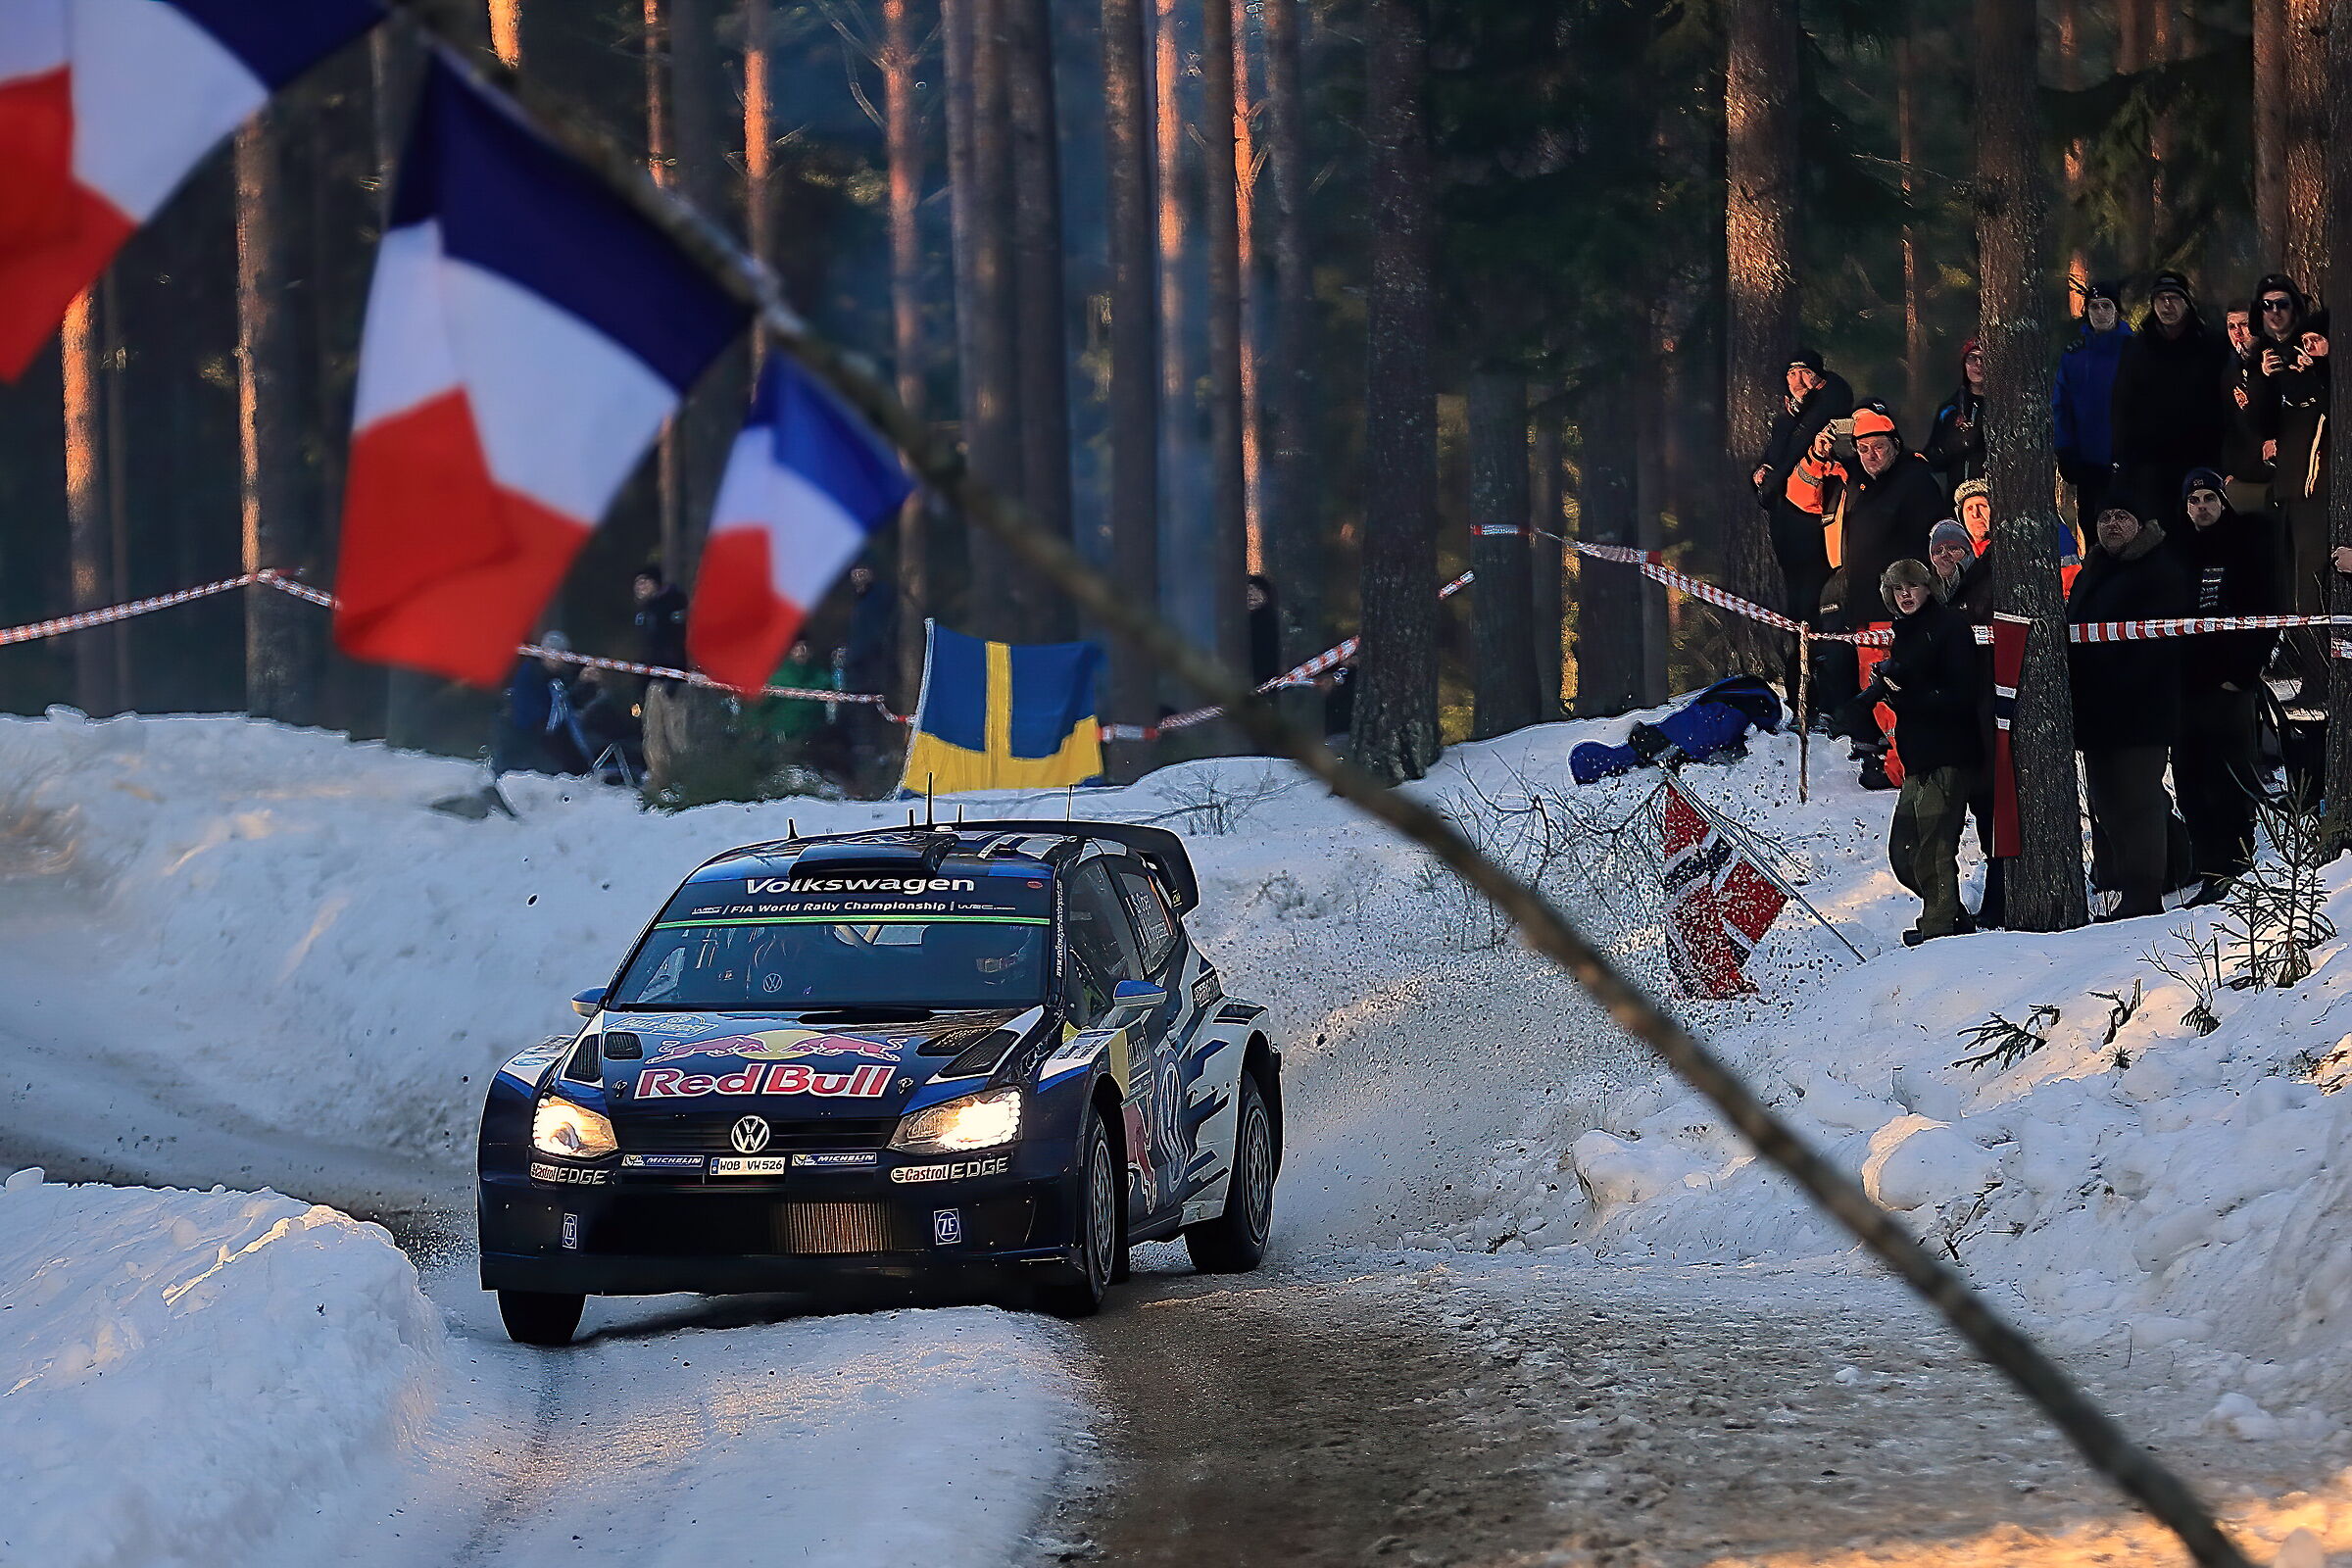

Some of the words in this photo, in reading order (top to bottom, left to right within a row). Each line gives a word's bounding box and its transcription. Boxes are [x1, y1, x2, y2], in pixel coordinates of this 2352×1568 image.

[745, 878, 975, 895] Volkswagen
[759, 903, 800, 912] World
[804, 902, 840, 912] Rally
[844, 900, 947, 911] Championship
[634, 1063, 767, 1100] Red
[761, 1063, 897, 1098] Bull
[645, 1155, 702, 1165] MICHELIN
[719, 1159, 741, 1171] WOB
[762, 1158, 783, 1171] 526
[816, 1153, 875, 1164] MICHELIN
[557, 1167, 610, 1185] EDGE
[905, 1165, 947, 1182] Castrol
[950, 1156, 1009, 1180] EDGE
[936, 1217, 956, 1236] ZF
